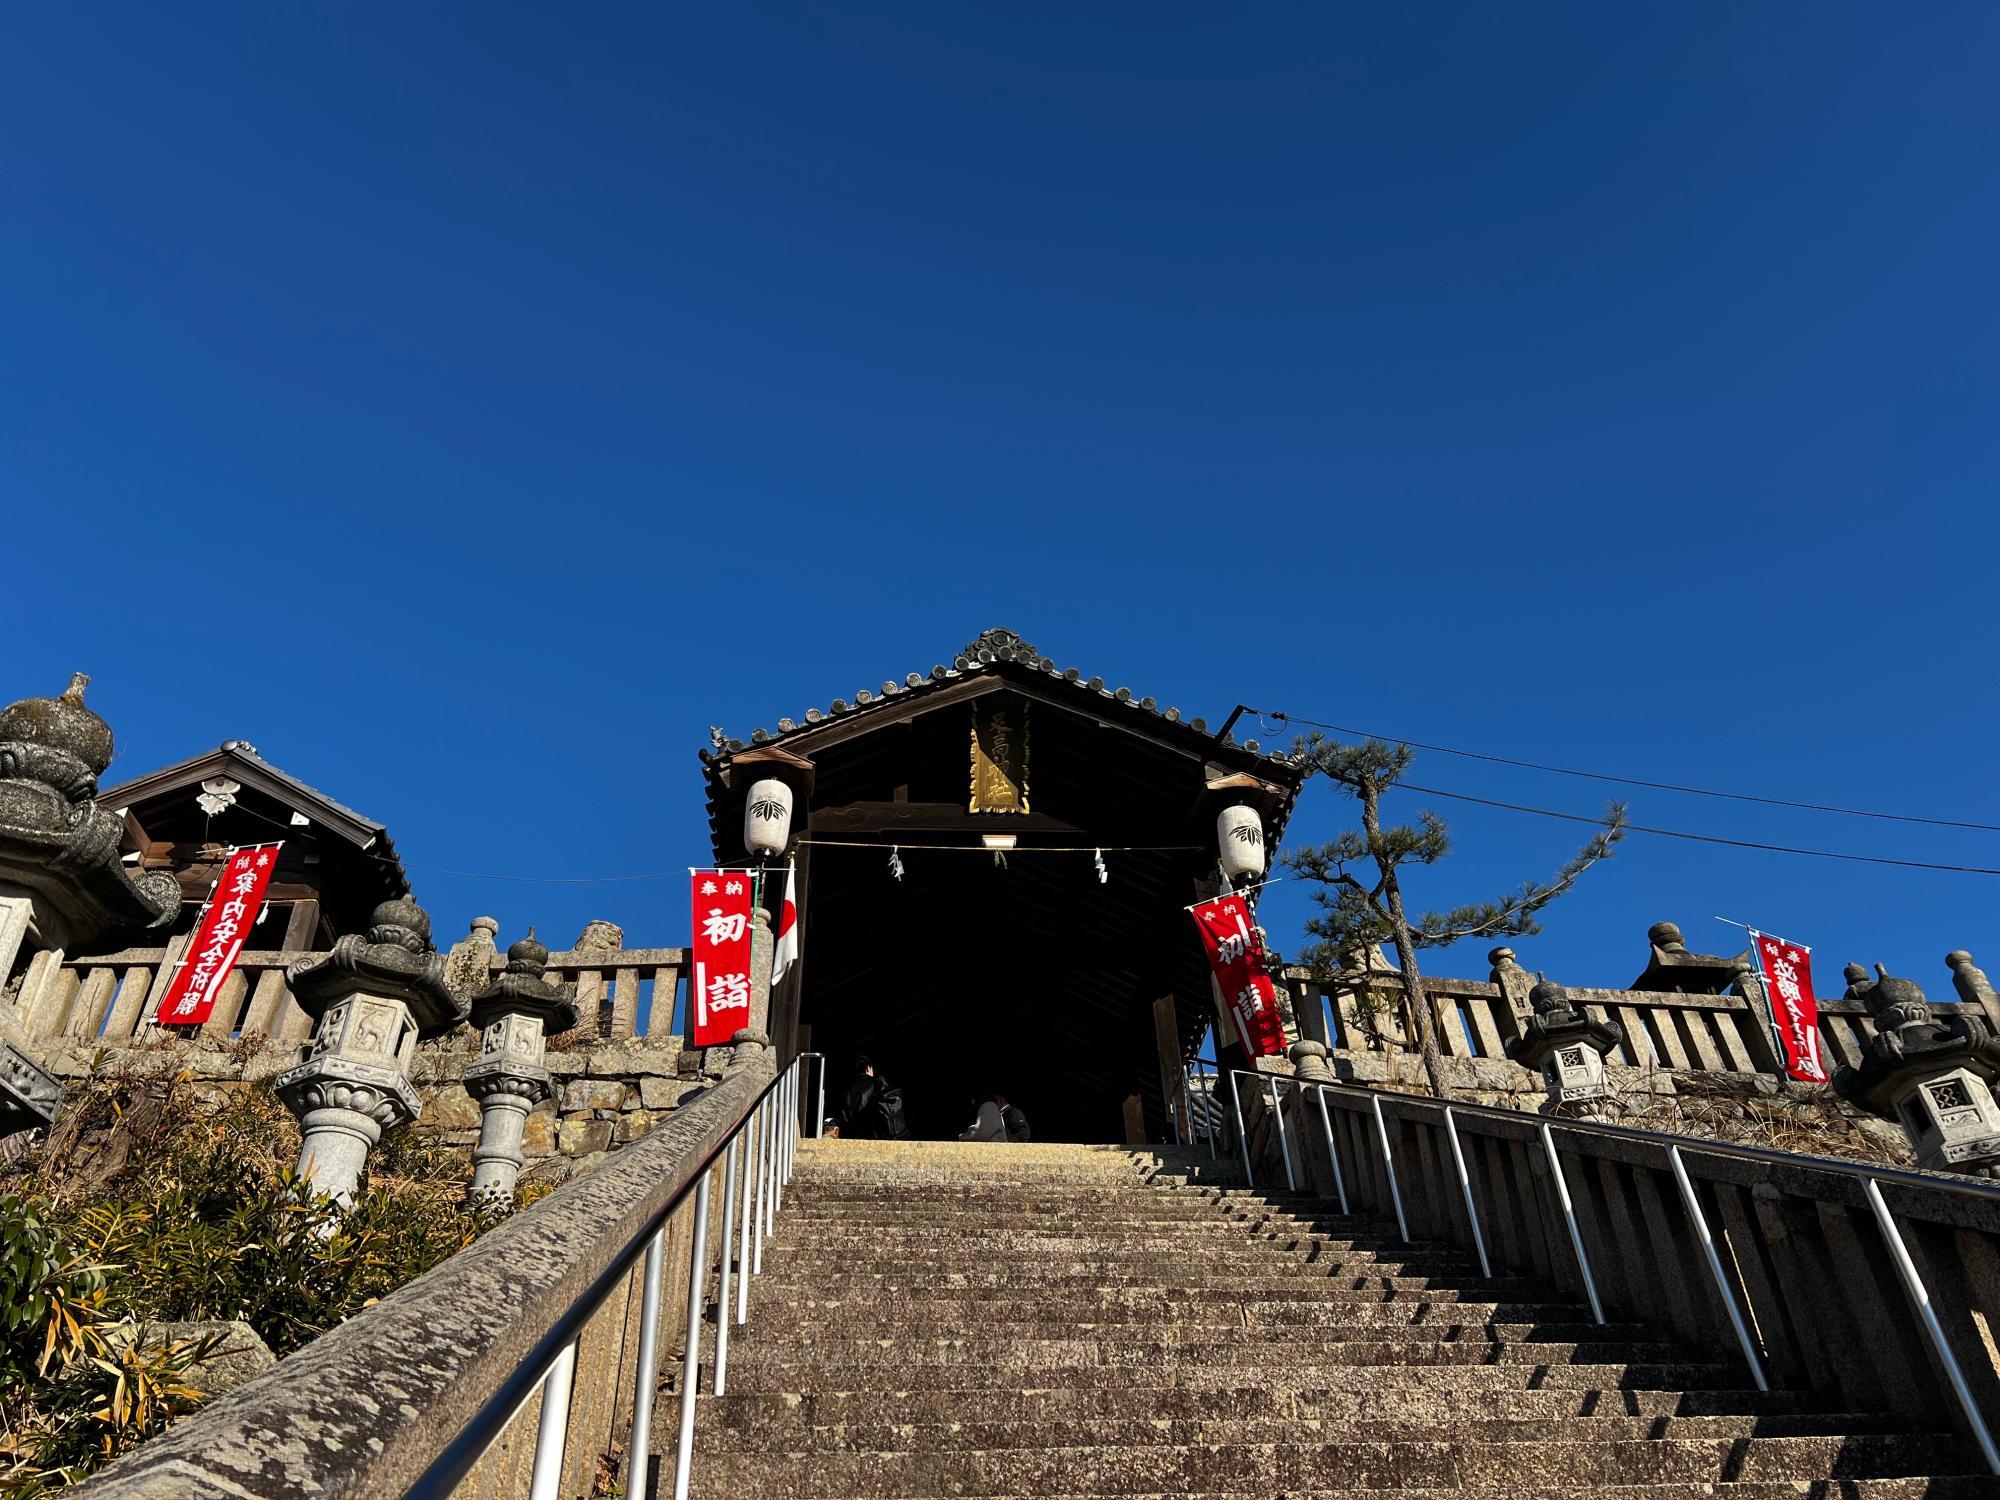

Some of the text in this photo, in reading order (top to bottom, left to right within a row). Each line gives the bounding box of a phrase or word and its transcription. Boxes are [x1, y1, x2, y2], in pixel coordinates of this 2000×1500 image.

[700, 880, 744, 896] 奉納
[1204, 904, 1236, 921] 奉納
[701, 908, 749, 1013] 初詣
[1218, 933, 1265, 1021] 初詣
